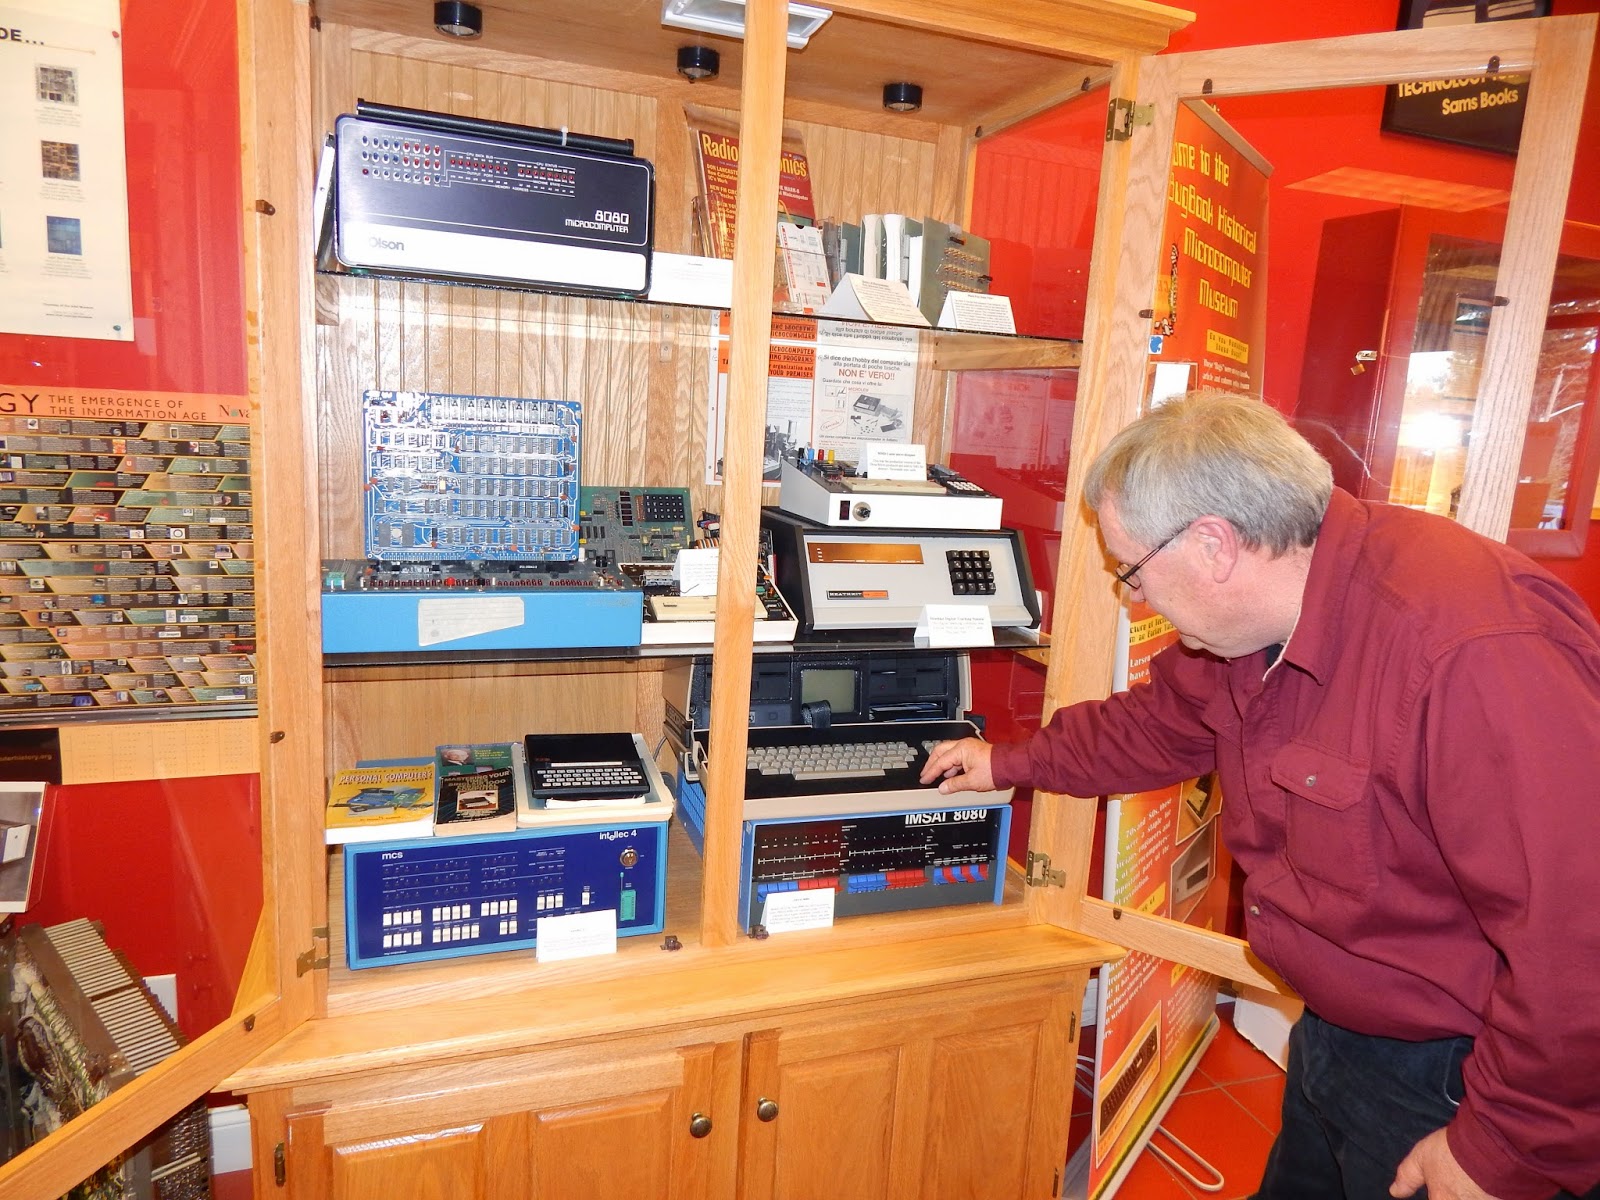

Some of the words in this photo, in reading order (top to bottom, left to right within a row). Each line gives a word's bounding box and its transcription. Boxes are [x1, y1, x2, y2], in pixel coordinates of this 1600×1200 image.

[1442, 96, 1478, 115] Sams
[1480, 88, 1519, 108] Books
[702, 134, 738, 162] Radio
[1200, 144, 1210, 176] to
[1215, 152, 1230, 187] the
[595, 210, 629, 225] 8080
[565, 218, 629, 234] MICROCOMPUTER
[1217, 205, 1257, 254] Historical
[368, 236, 404, 251] Olson
[1184, 226, 1252, 289] Microcomputer
[1199, 278, 1238, 319] Museum
[770, 346, 814, 354] ICROCOMPUTER
[838, 369, 857, 378] NON
[868, 371, 895, 380] VERO!!
[0, 392, 39, 414] GY
[49, 394, 74, 405] THE
[82, 396, 161, 408] EMERGENCE
[168, 400, 184, 409] OF
[50, 406, 75, 416] THE
[82, 407, 177, 419] INFORMATION
[183, 411, 207, 420] AGE
[1130, 655, 1151, 668] Larsen
[340, 774, 382, 782] PERSONAL
[384, 771, 433, 780] COMPUTERS
[489, 770, 510, 778] YOUR
[953, 809, 987, 821] 8080
[599, 830, 629, 841] intellec
[382, 851, 404, 860] mcs
